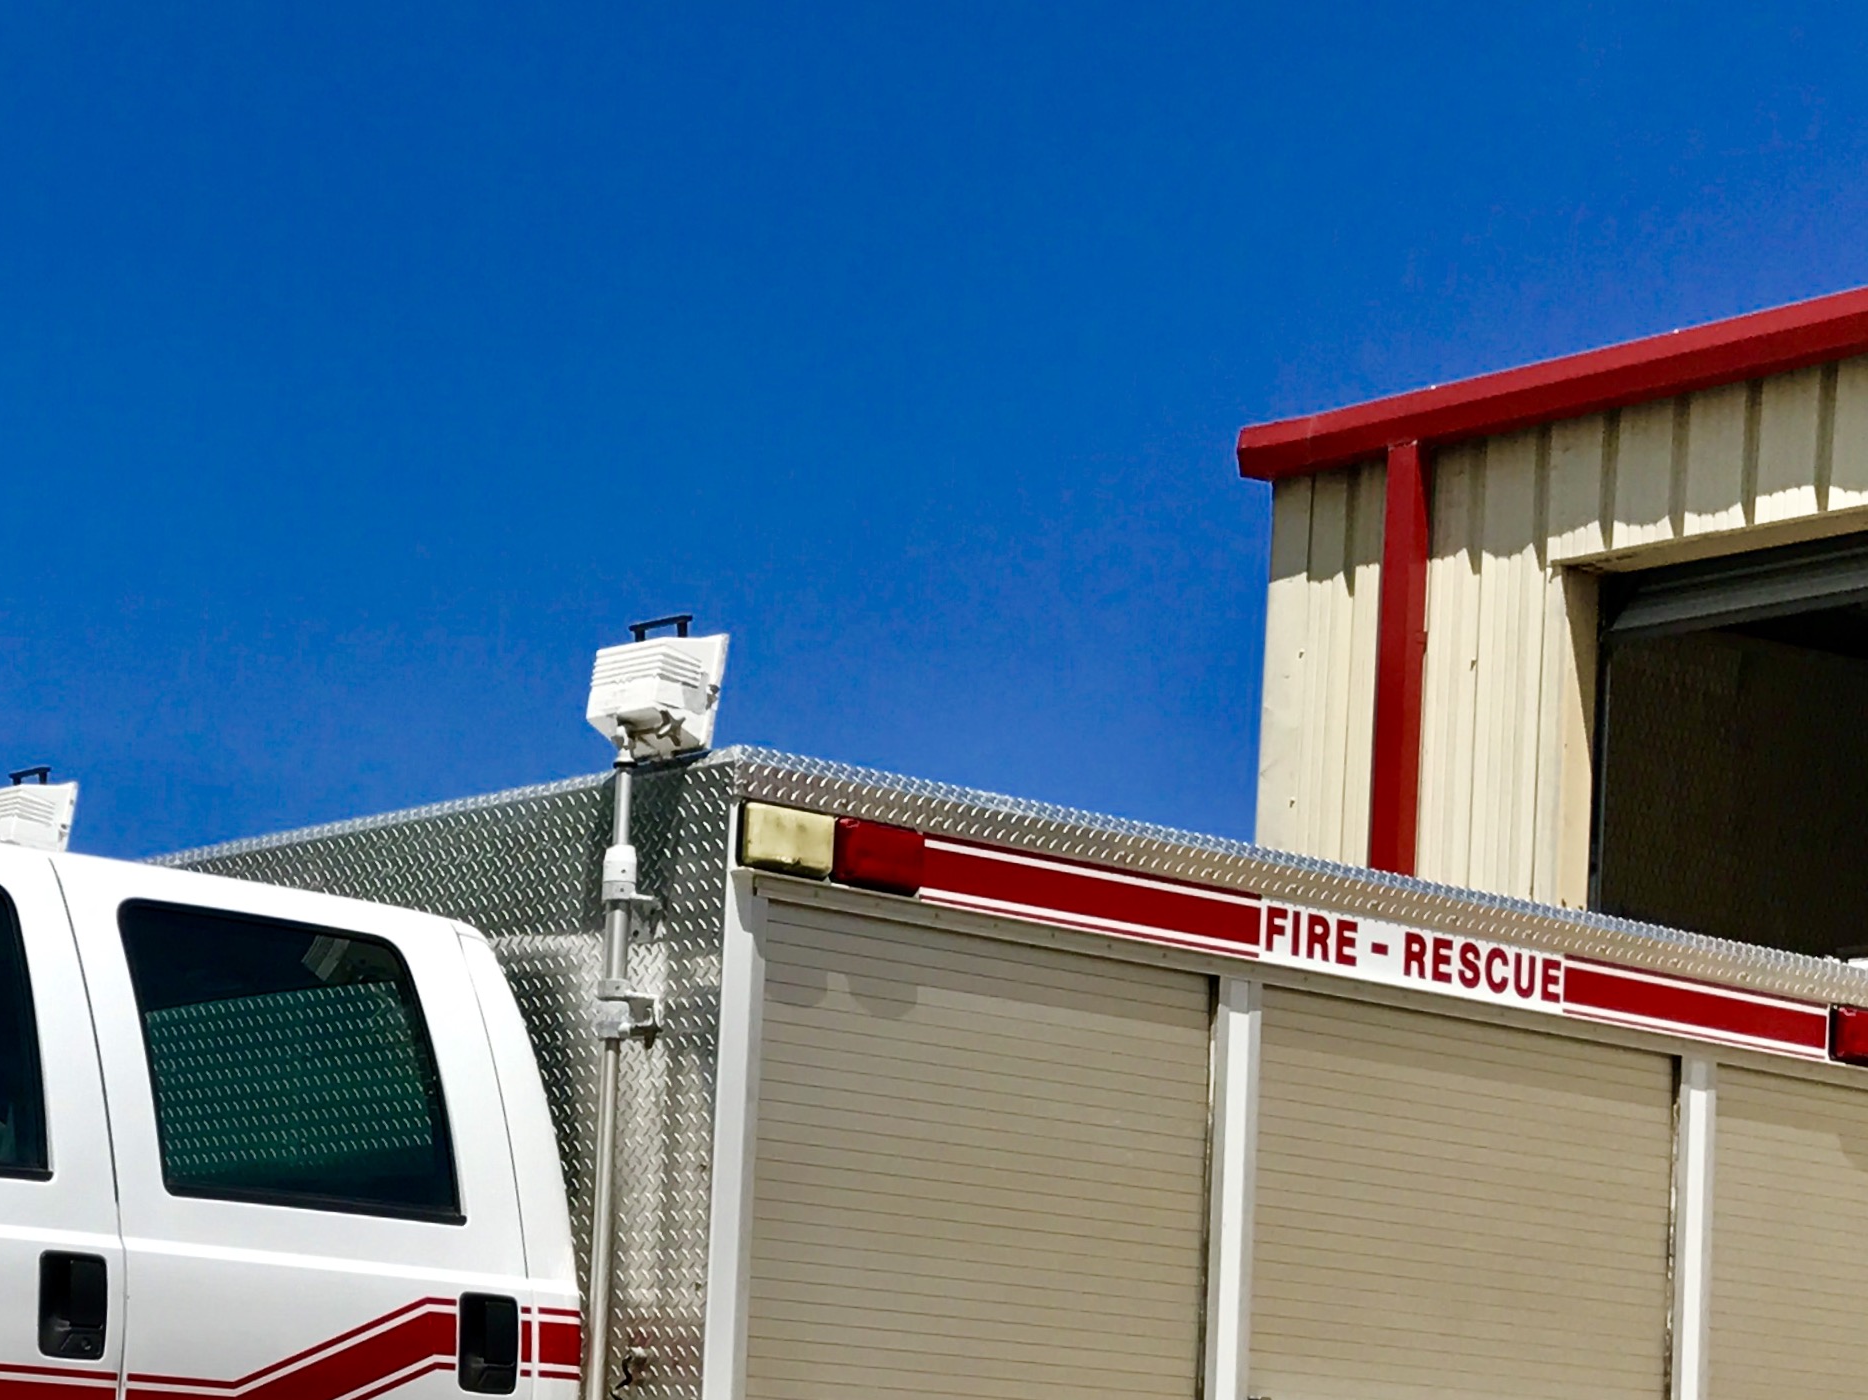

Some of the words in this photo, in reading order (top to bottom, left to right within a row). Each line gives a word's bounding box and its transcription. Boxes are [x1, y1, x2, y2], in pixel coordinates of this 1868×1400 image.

[1265, 905, 1359, 967] FIRE
[1370, 942, 1389, 956] -
[1403, 931, 1562, 1004] RESCUE
